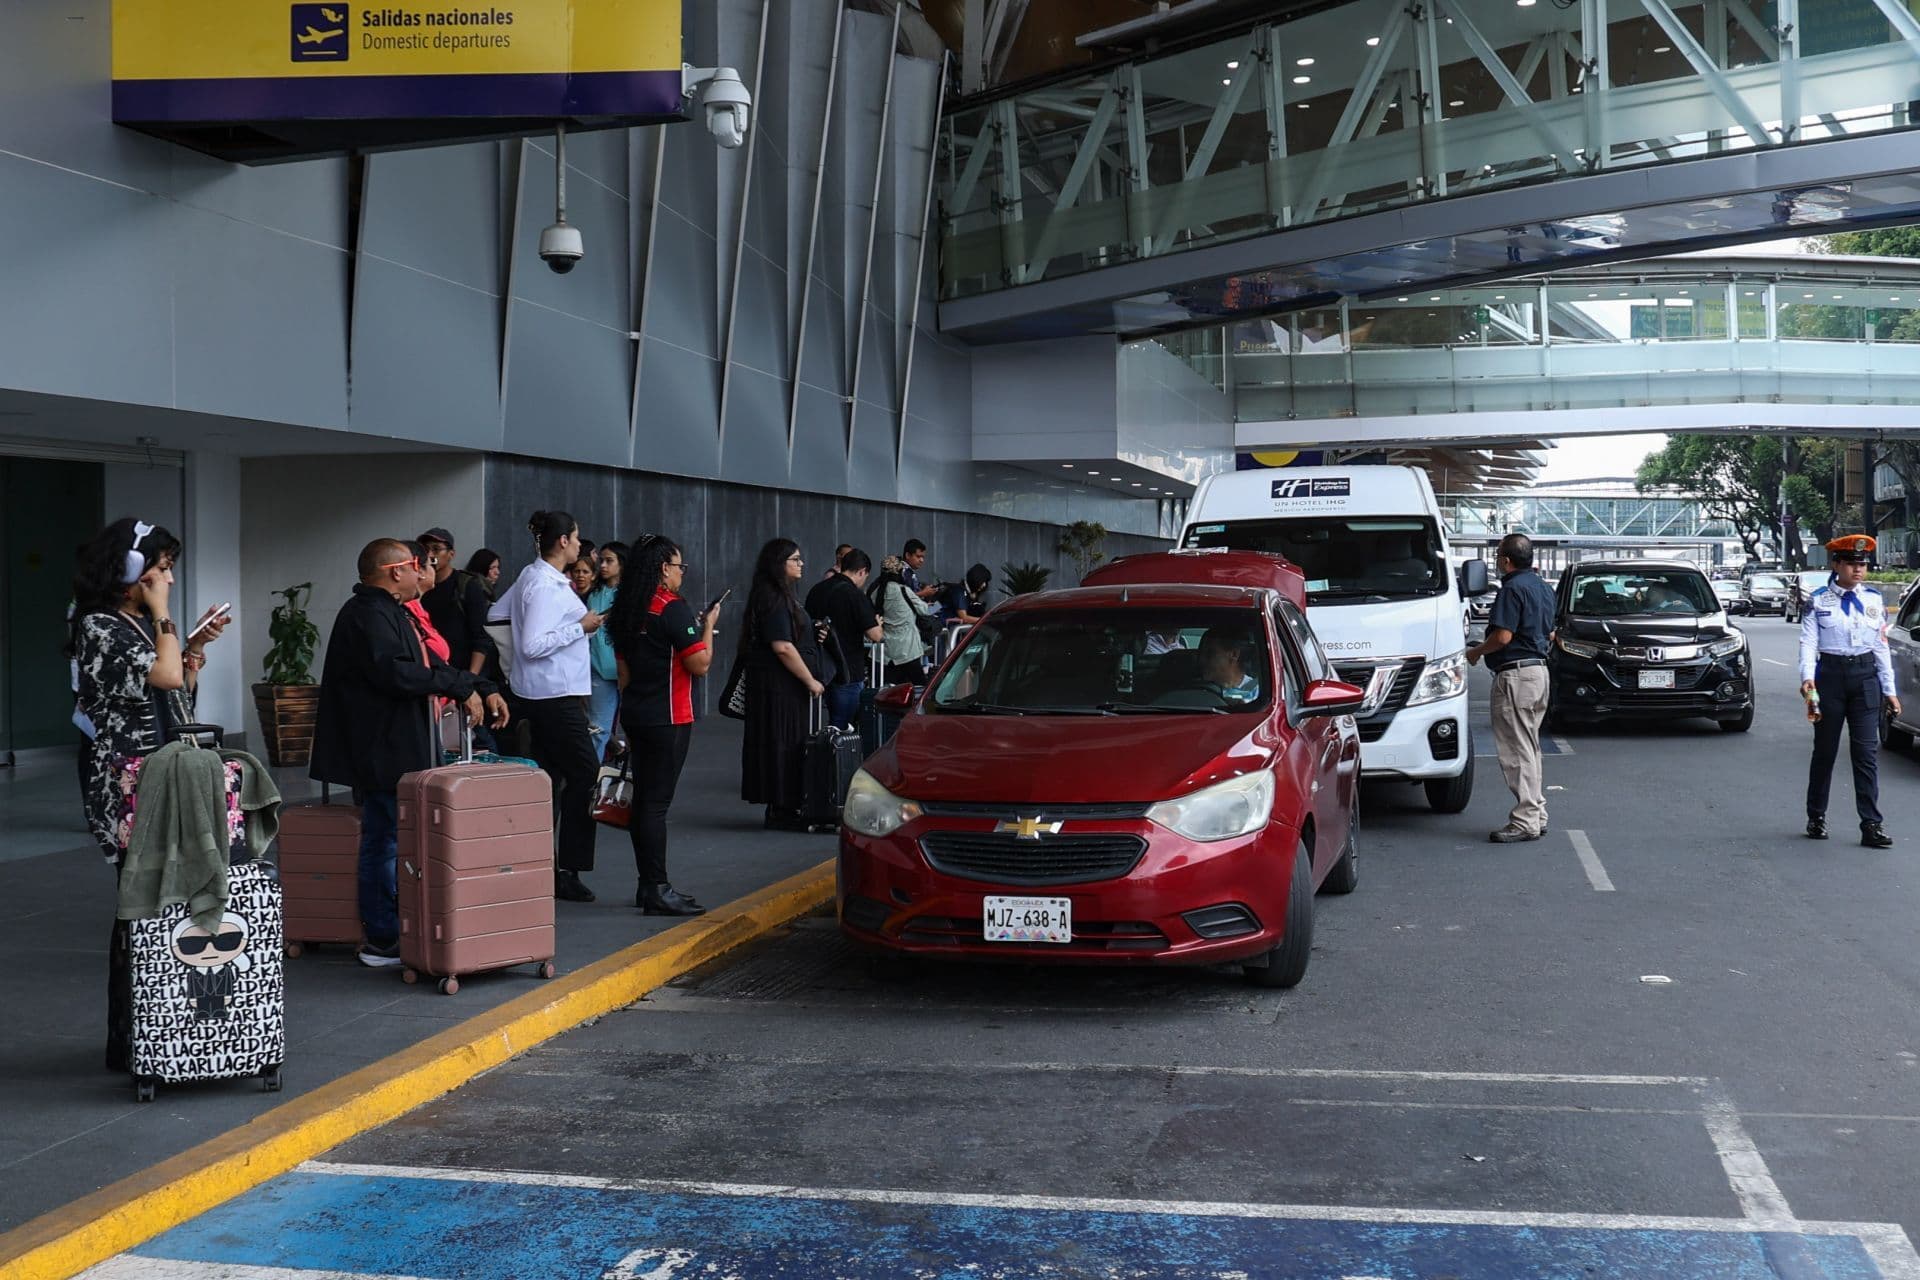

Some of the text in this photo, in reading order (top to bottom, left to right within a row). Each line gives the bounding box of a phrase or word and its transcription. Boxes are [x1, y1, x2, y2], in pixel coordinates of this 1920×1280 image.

[362, 8, 513, 27] Salidas nacionales
[363, 31, 510, 53] Domestic departures
[987, 908, 1068, 929] MJZ-638-A
[218, 1022, 262, 1041] PARIS
[135, 1042, 171, 1058] KARL
[173, 1038, 260, 1057] LAGERFELD
[135, 1058, 176, 1076] PARIS
[177, 1057, 214, 1076] KARL
